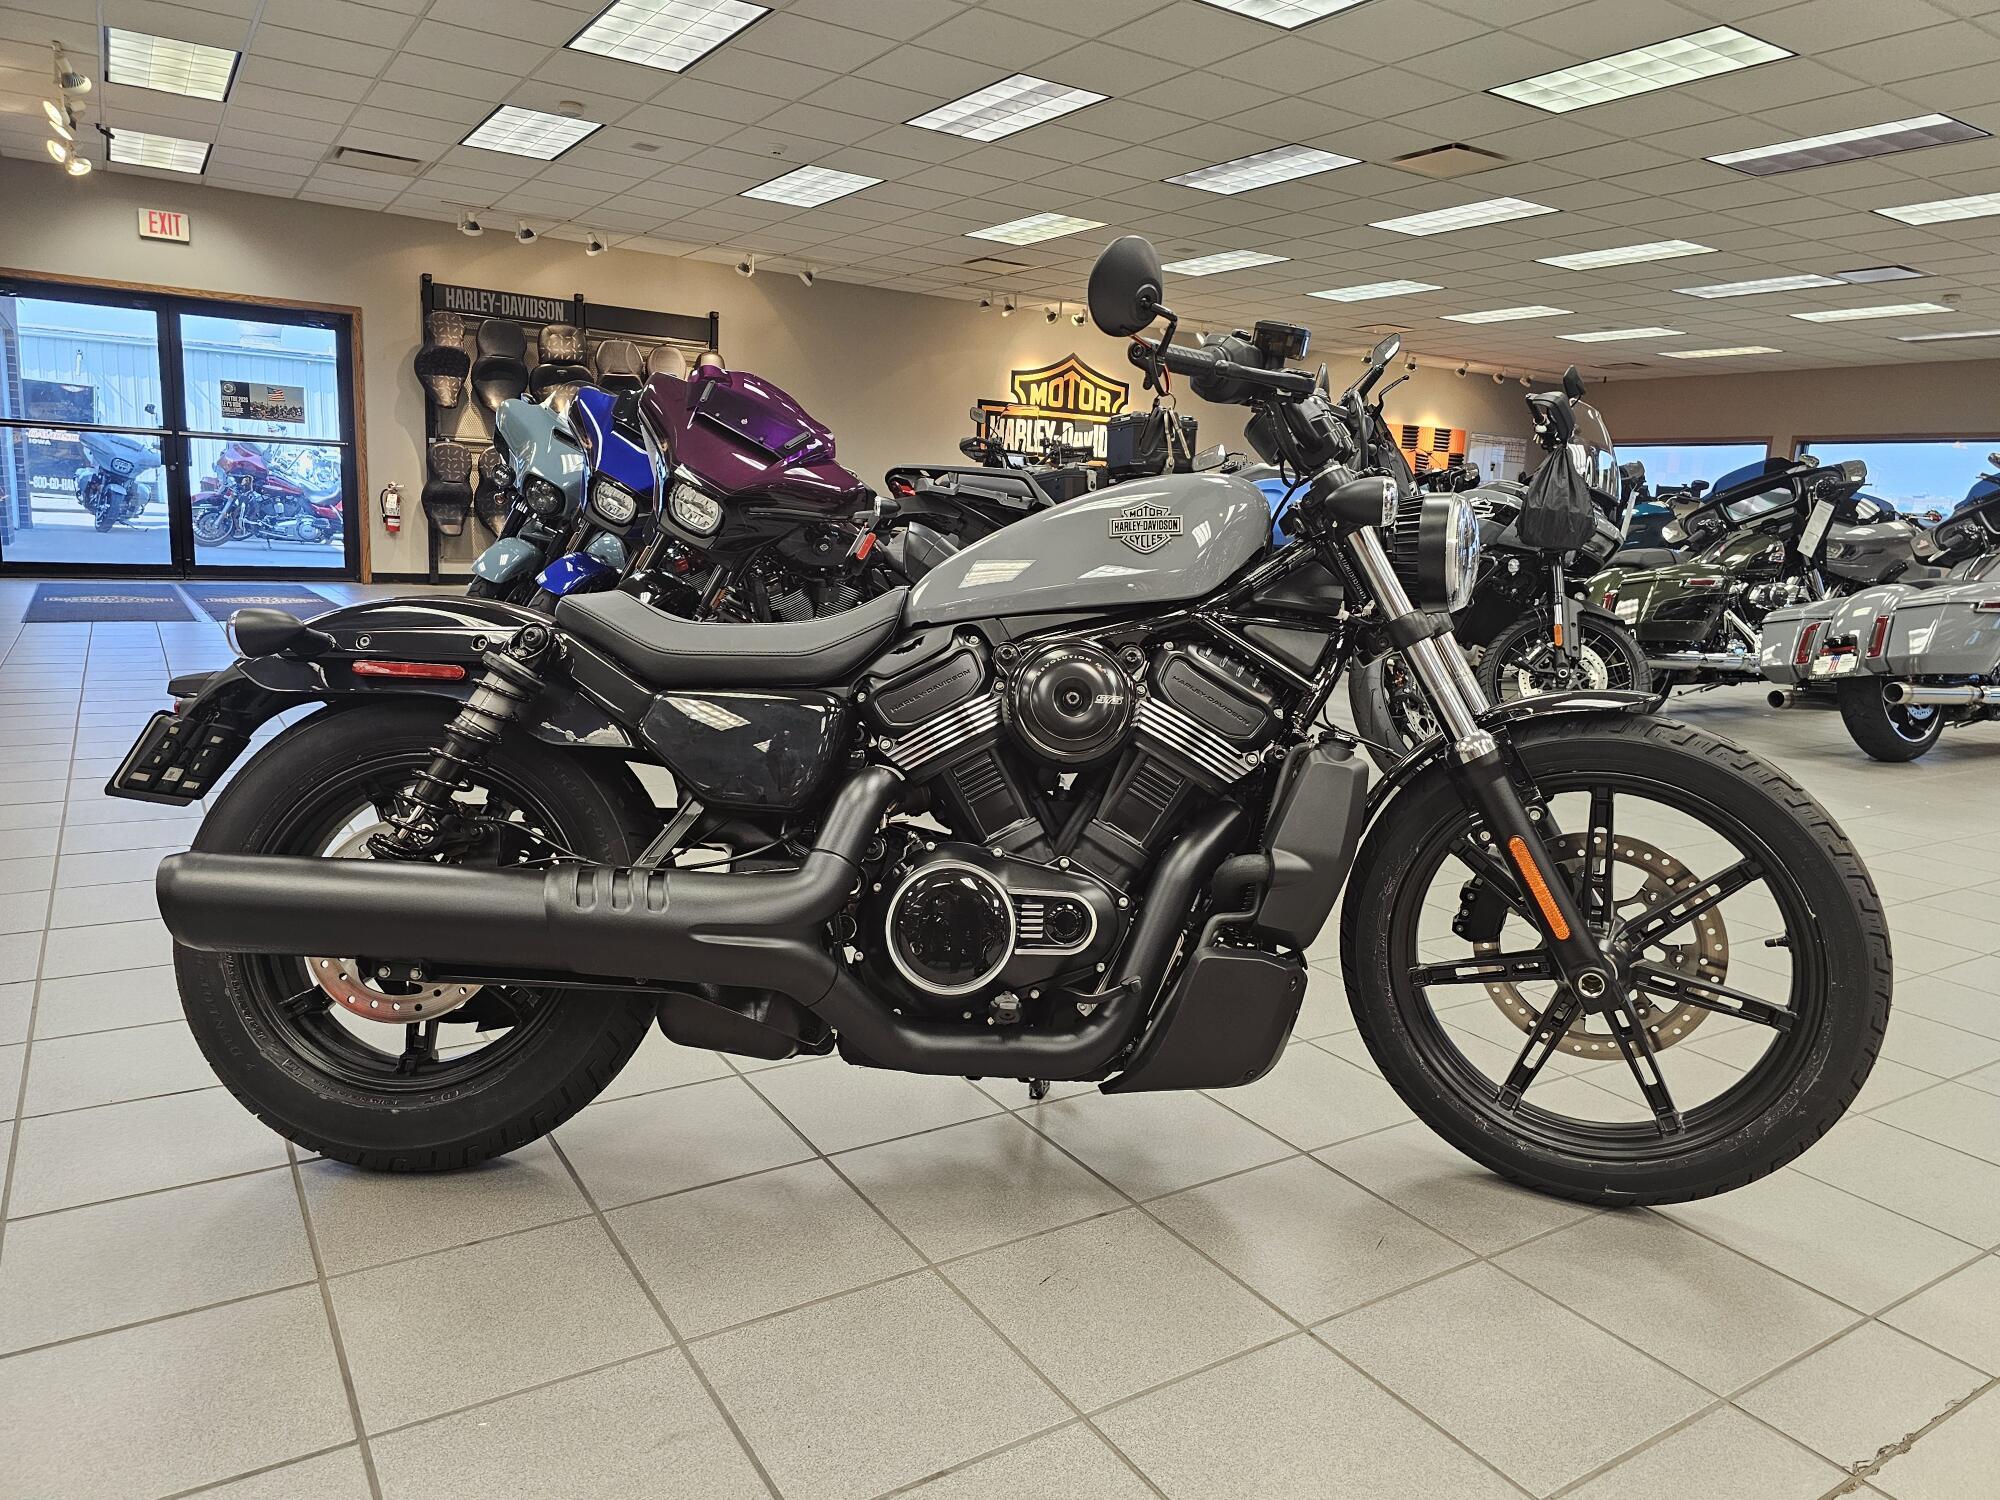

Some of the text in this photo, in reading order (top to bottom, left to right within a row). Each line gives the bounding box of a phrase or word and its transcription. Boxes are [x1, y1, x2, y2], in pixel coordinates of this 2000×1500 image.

[148, 210, 181, 237] EXIT
[445, 287, 564, 321] HARLEY-DAVIDSON
[1029, 369, 1112, 414] MOTOR
[28, 438, 52, 446] IOWA
[988, 414, 1107, 458] HARLEY-DID
[1129, 505, 1163, 518] MOTOR
[1114, 519, 1179, 532] HARLEY-DAVIDSON
[1129, 534, 1163, 548] CYCLES
